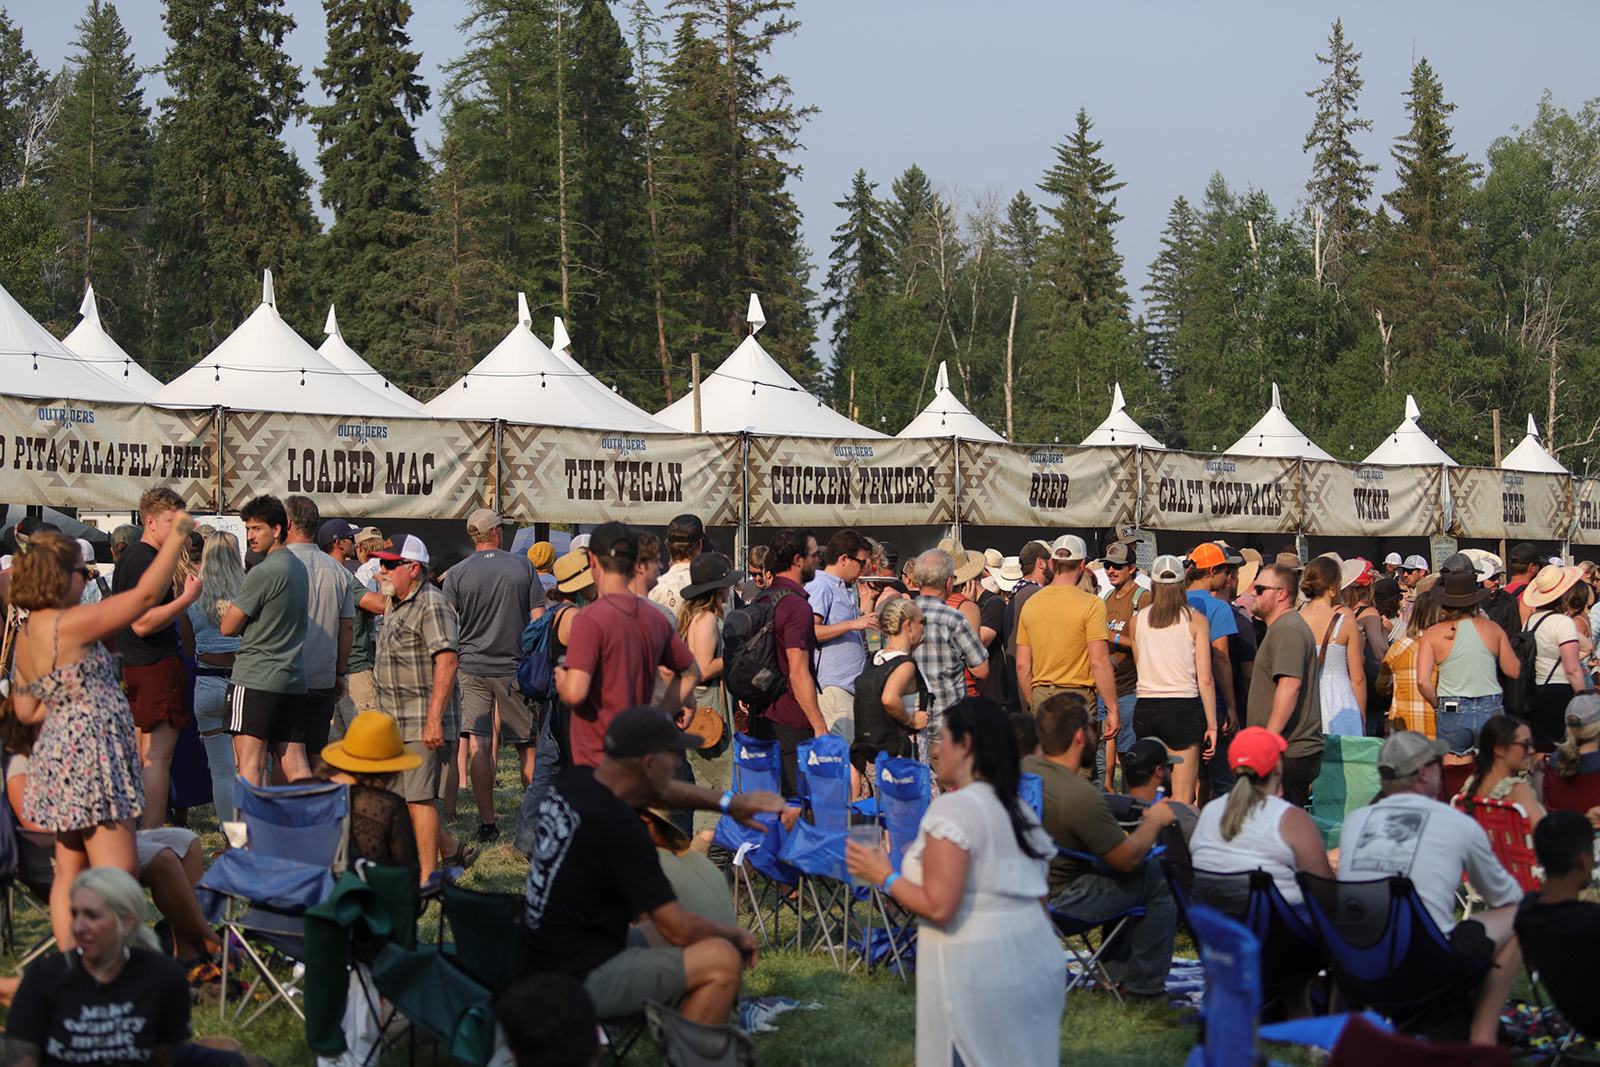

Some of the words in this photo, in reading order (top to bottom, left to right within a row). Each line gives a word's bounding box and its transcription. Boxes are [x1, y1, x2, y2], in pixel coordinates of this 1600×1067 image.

[14, 436, 211, 479] PITA/FALAFEL/FRIES
[288, 448, 375, 494] LOADED
[385, 451, 435, 496] MAC
[564, 458, 606, 500] THE
[614, 461, 683, 502] VEGAN
[771, 465, 850, 505] CHICKEN
[858, 466, 935, 504] TENDERS
[1029, 472, 1070, 508] BEER
[1159, 477, 1204, 513] CRAFT
[1209, 480, 1282, 516] COCKTAILS
[1353, 488, 1390, 520] WINE
[1502, 492, 1526, 523] BEER
